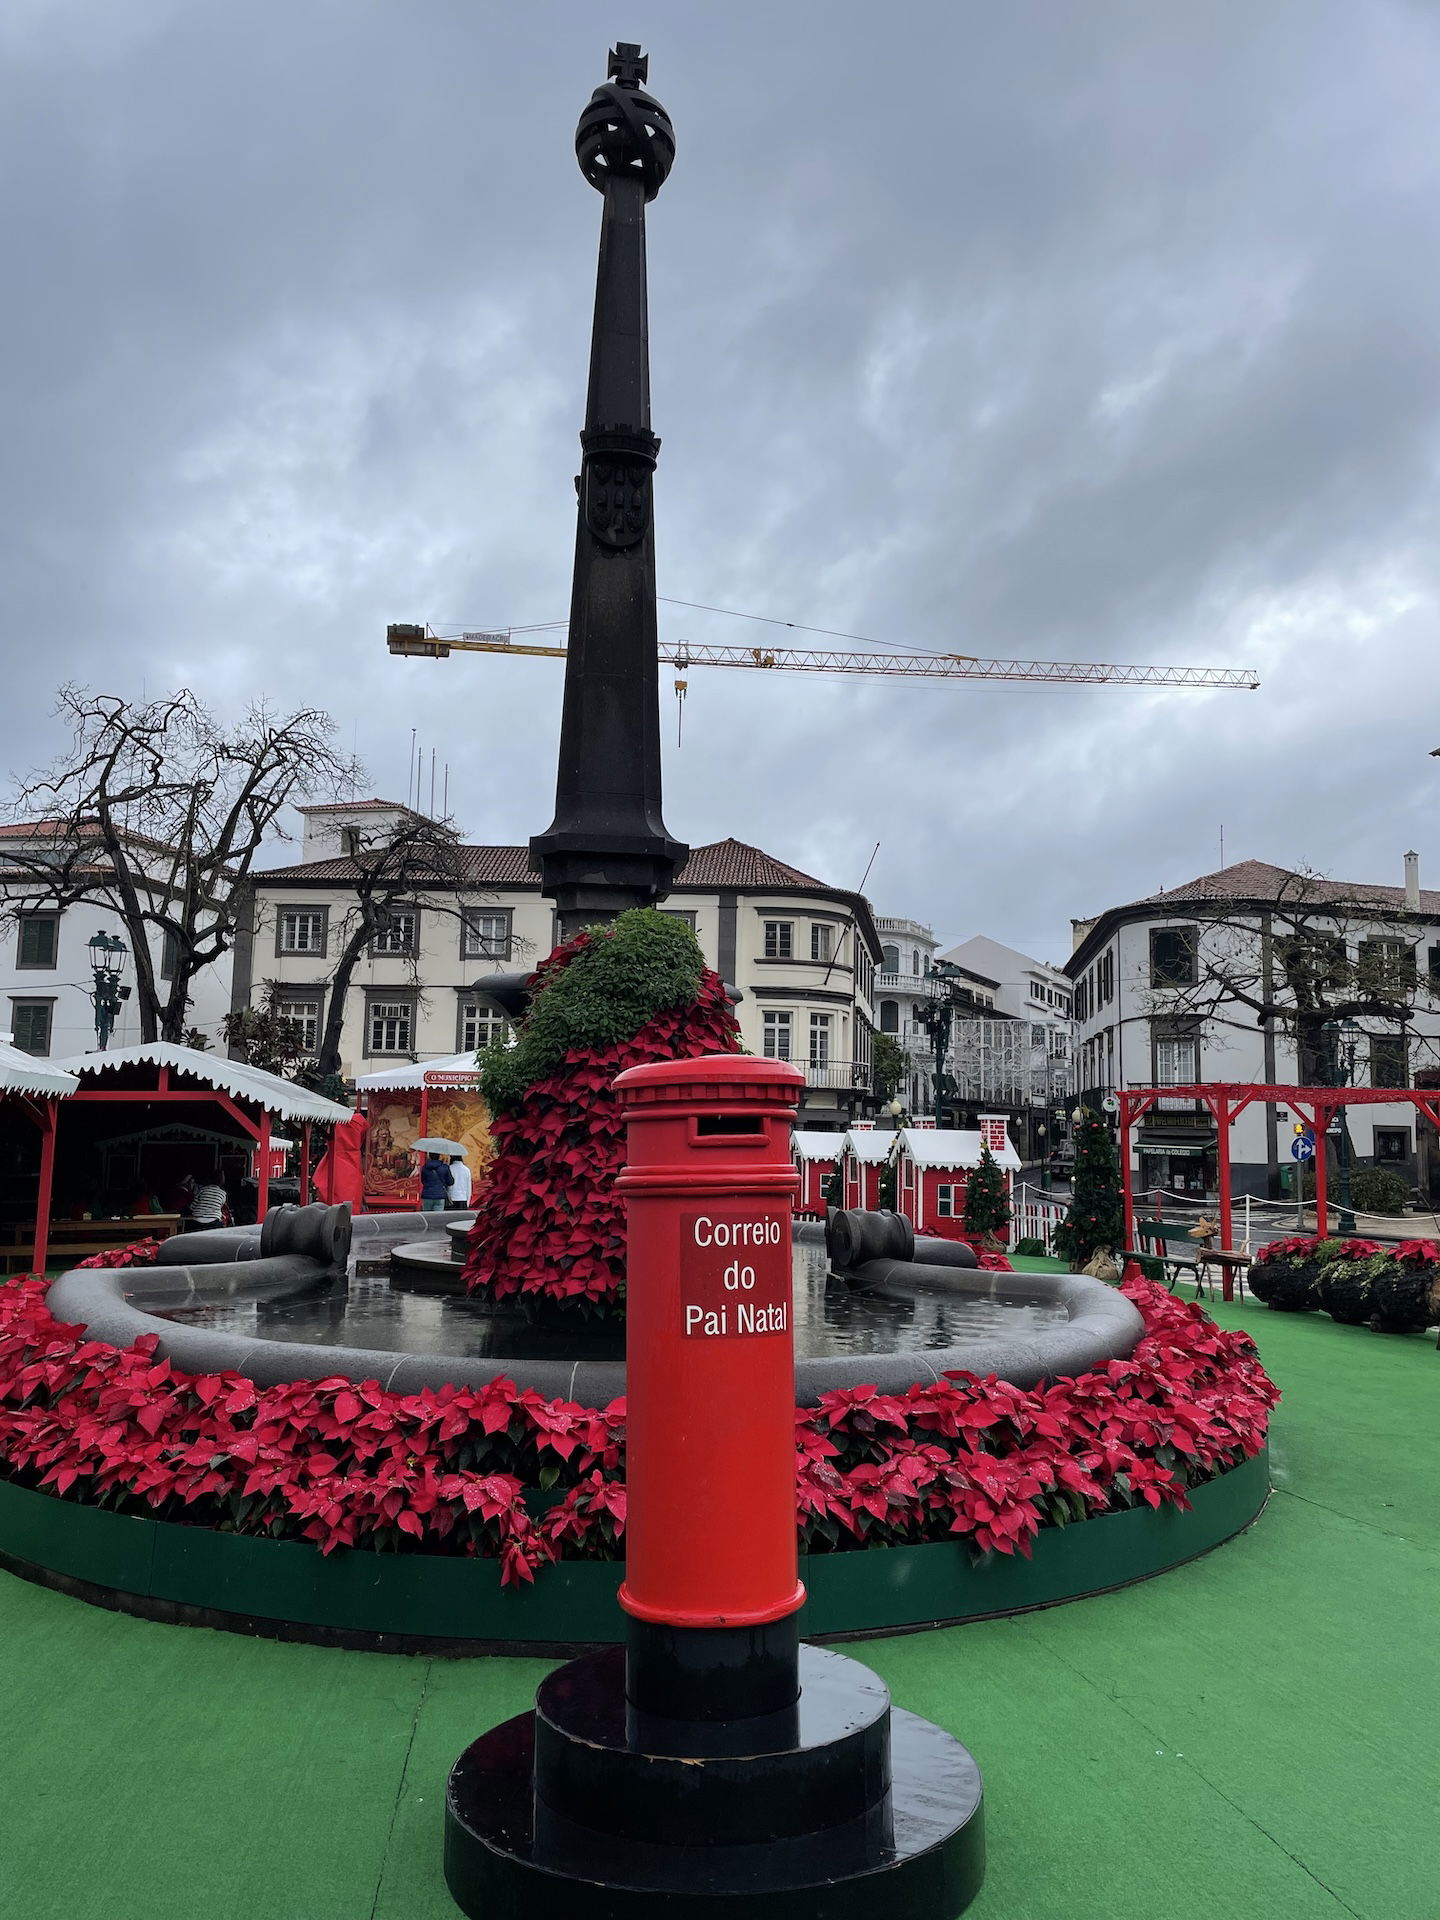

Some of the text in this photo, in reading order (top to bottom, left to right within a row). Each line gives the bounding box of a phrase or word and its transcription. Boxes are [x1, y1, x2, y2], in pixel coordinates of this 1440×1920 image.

[694, 1215, 781, 1247] Correio
[723, 1260, 756, 1290] do
[686, 1301, 787, 1335] Pai Natal
